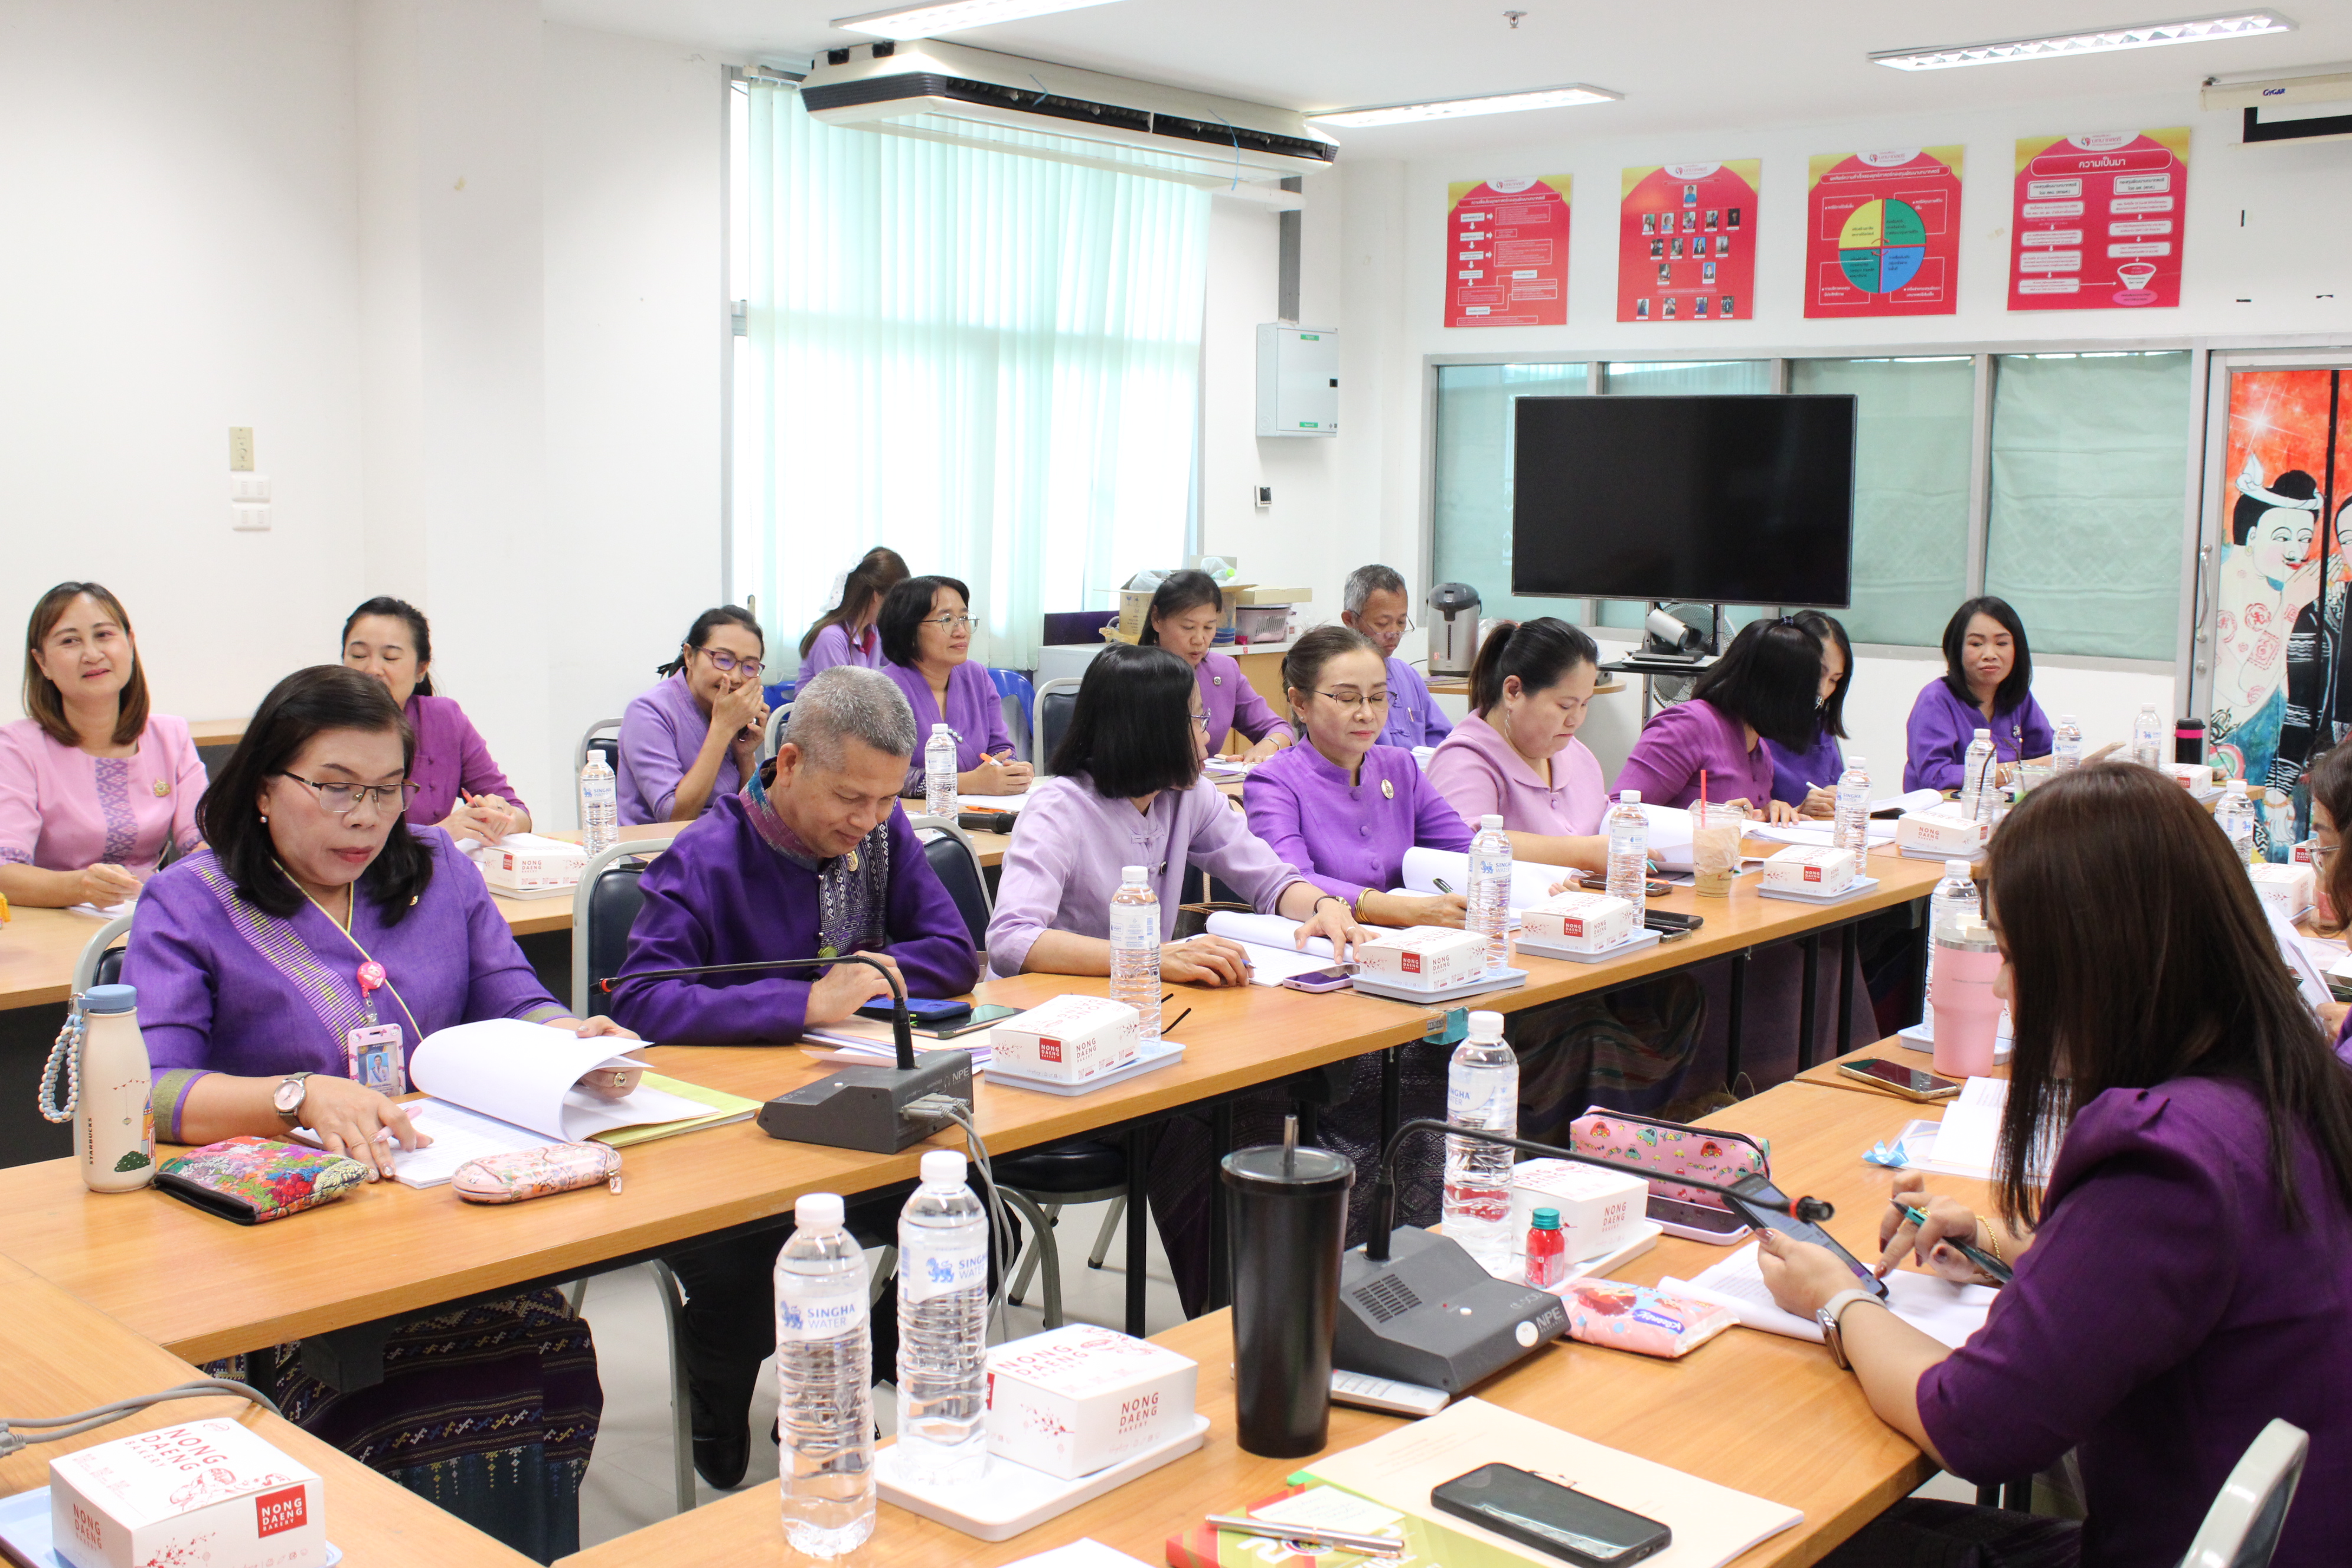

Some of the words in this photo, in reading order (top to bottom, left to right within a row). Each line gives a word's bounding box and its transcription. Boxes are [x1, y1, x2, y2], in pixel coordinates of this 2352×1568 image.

[2079, 156, 2126, 168] ความเป็นมา
[1919, 827, 1939, 835] NONG
[1594, 920, 1606, 929] NONG
[1594, 926, 1607, 935] DAENG
[1433, 955, 1450, 965] NONG
[1433, 961, 1451, 971] DAENG
[1076, 1038, 1096, 1052] NONG
[1076, 1047, 1097, 1059] DAENG
[1077, 1054, 1093, 1063] BAKERY
[952, 1067, 969, 1082] NPE
[1450, 1087, 1471, 1099] NGHA
[1520, 1171, 1567, 1187] DAENG
[1604, 1201, 1626, 1216] NONG
[1603, 1214, 1625, 1226] DAENG
[808, 1304, 855, 1318] SINGHA
[1535, 1306, 1563, 1329] NPE
[808, 1317, 847, 1329] WATER
[1639, 1310, 1681, 1330] Kleenex
[996, 1345, 1073, 1370] NONG
[1015, 1351, 1089, 1376] DAENG
[1121, 1392, 1159, 1415] NONG
[1119, 1406, 1158, 1427] DAENG
[1119, 1421, 1148, 1435] BAKERY
[140, 1435, 201, 1471] DAENG
[164, 1428, 228, 1464] NONG
[125, 1440, 167, 1468] BAKERY
[262, 1497, 303, 1517] NONG
[73, 1502, 102, 1535] NONG
[262, 1507, 303, 1526] DAENG
[263, 1518, 295, 1532] BAKERY
[74, 1518, 103, 1550] DAENG
[75, 1530, 98, 1552] BAKERY
